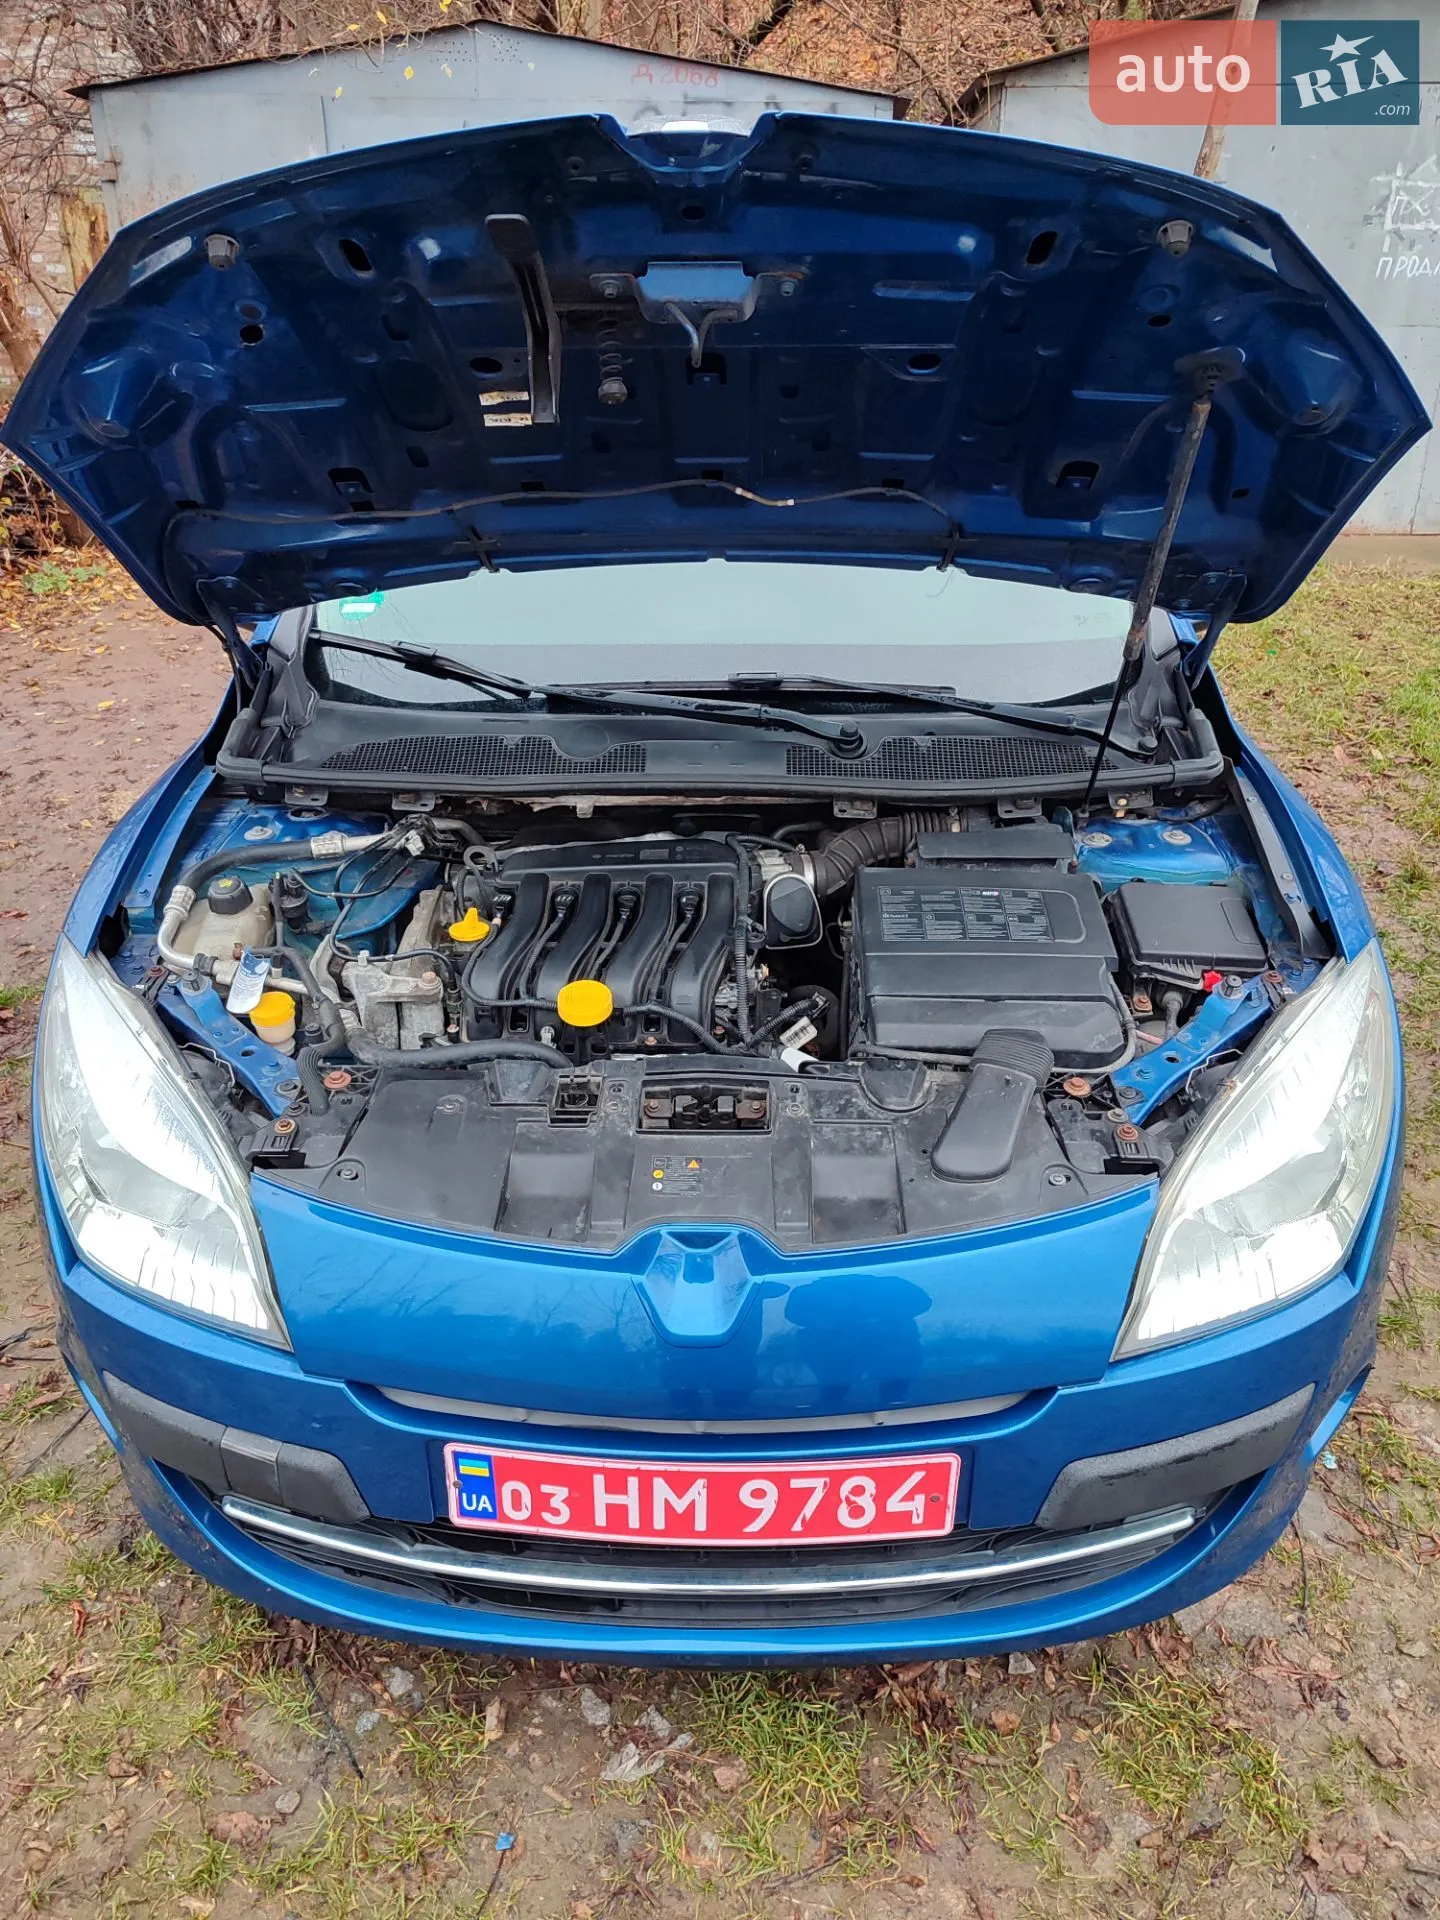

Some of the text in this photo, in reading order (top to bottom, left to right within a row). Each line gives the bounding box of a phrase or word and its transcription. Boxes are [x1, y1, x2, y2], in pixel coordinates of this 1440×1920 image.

[462, 1492, 494, 1513] UA
[501, 1470, 926, 1533] 03 HM 9784
